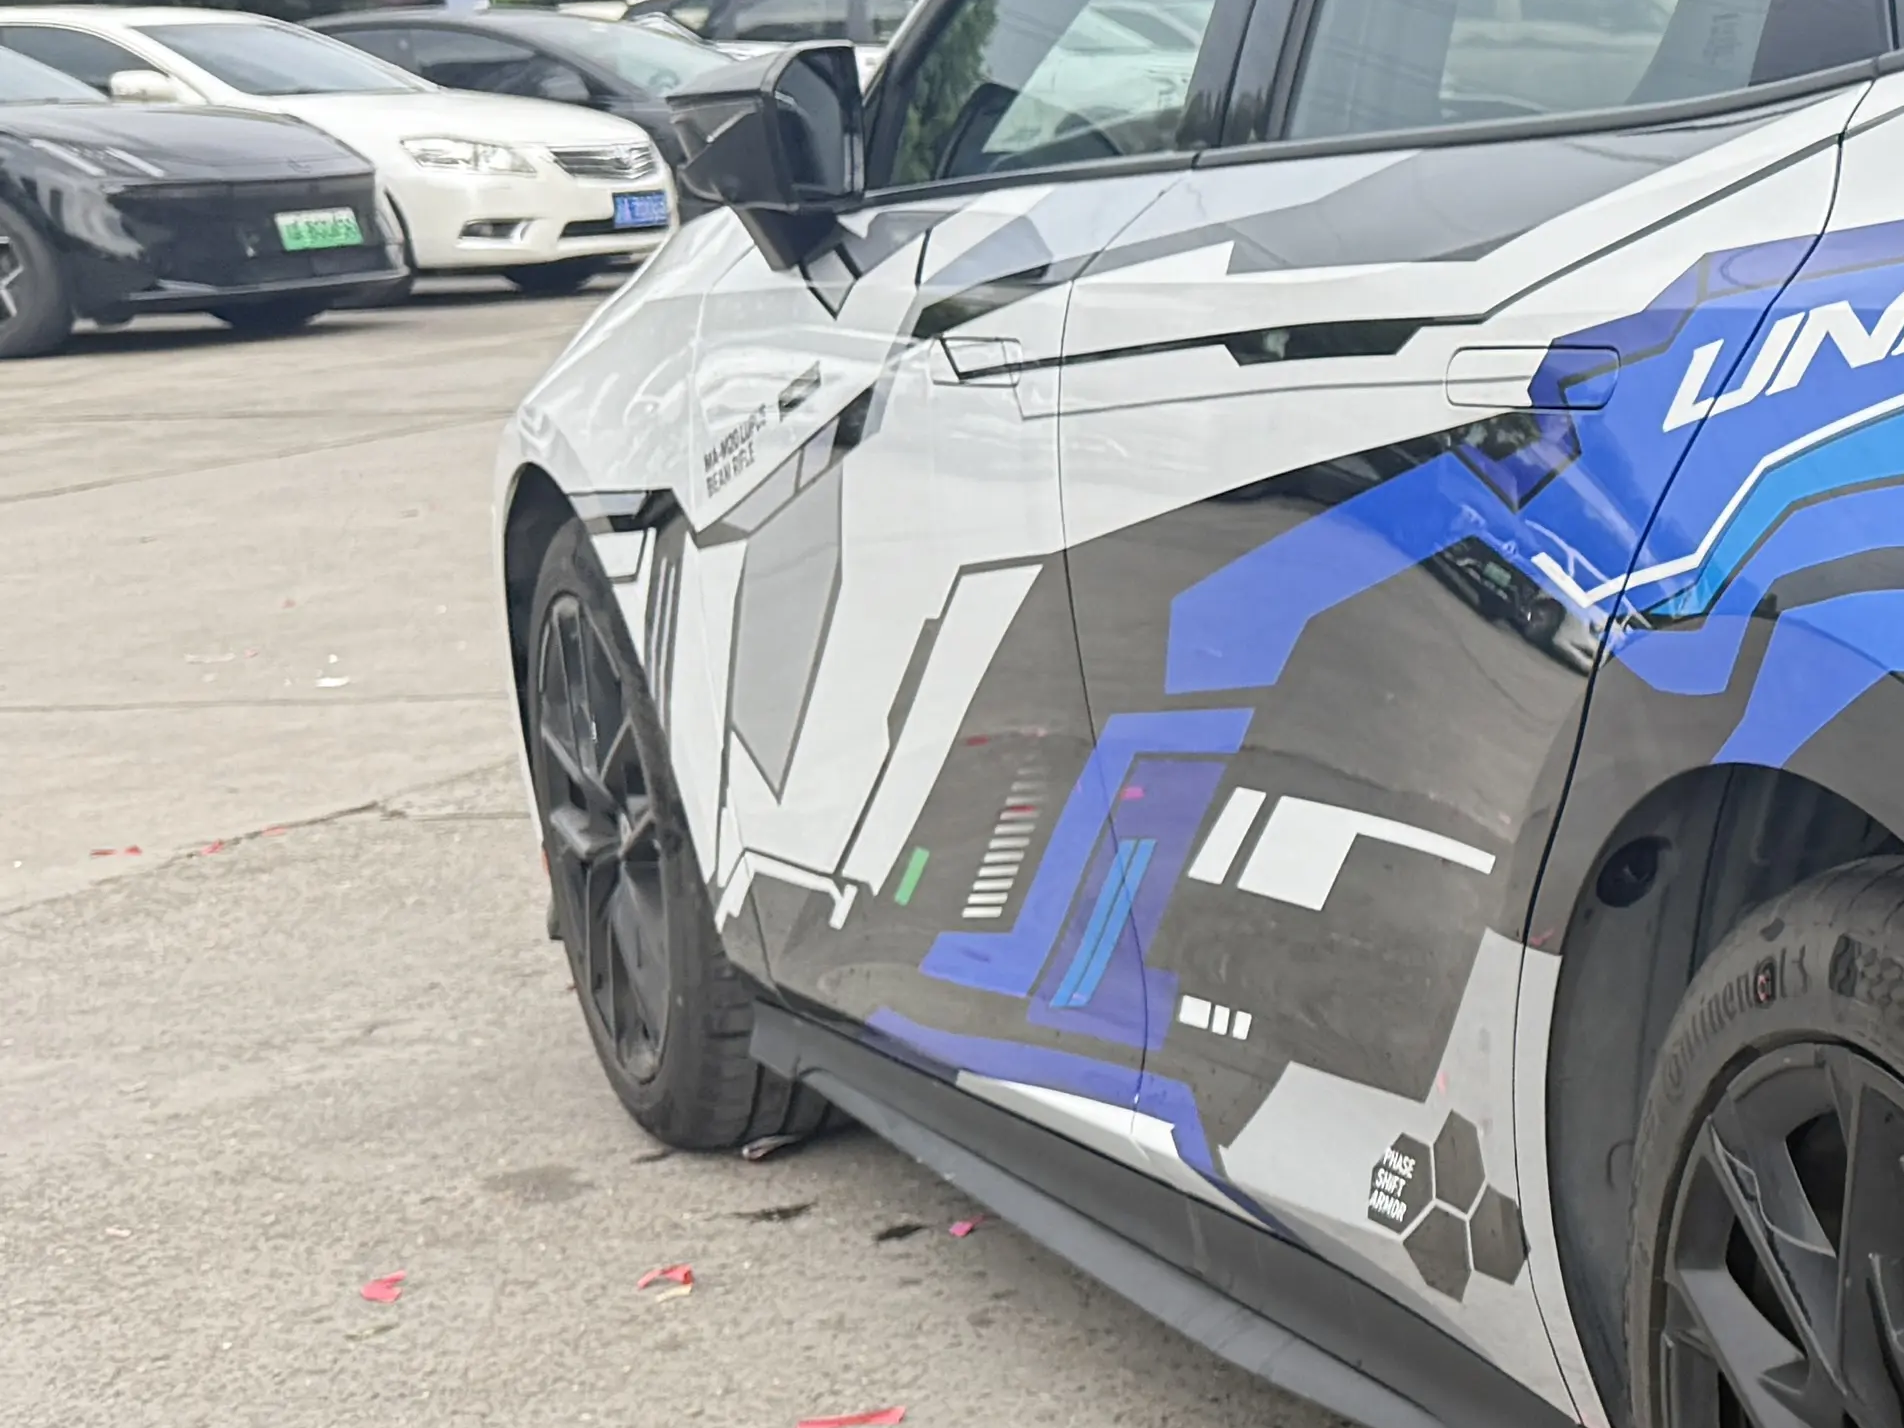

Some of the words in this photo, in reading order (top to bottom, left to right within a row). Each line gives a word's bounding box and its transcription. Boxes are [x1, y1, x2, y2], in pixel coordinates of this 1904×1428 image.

[1382, 1146, 1416, 1180] PHASE
[1375, 1167, 1407, 1198] SHIFT
[1369, 1189, 1408, 1223] ARMOR
